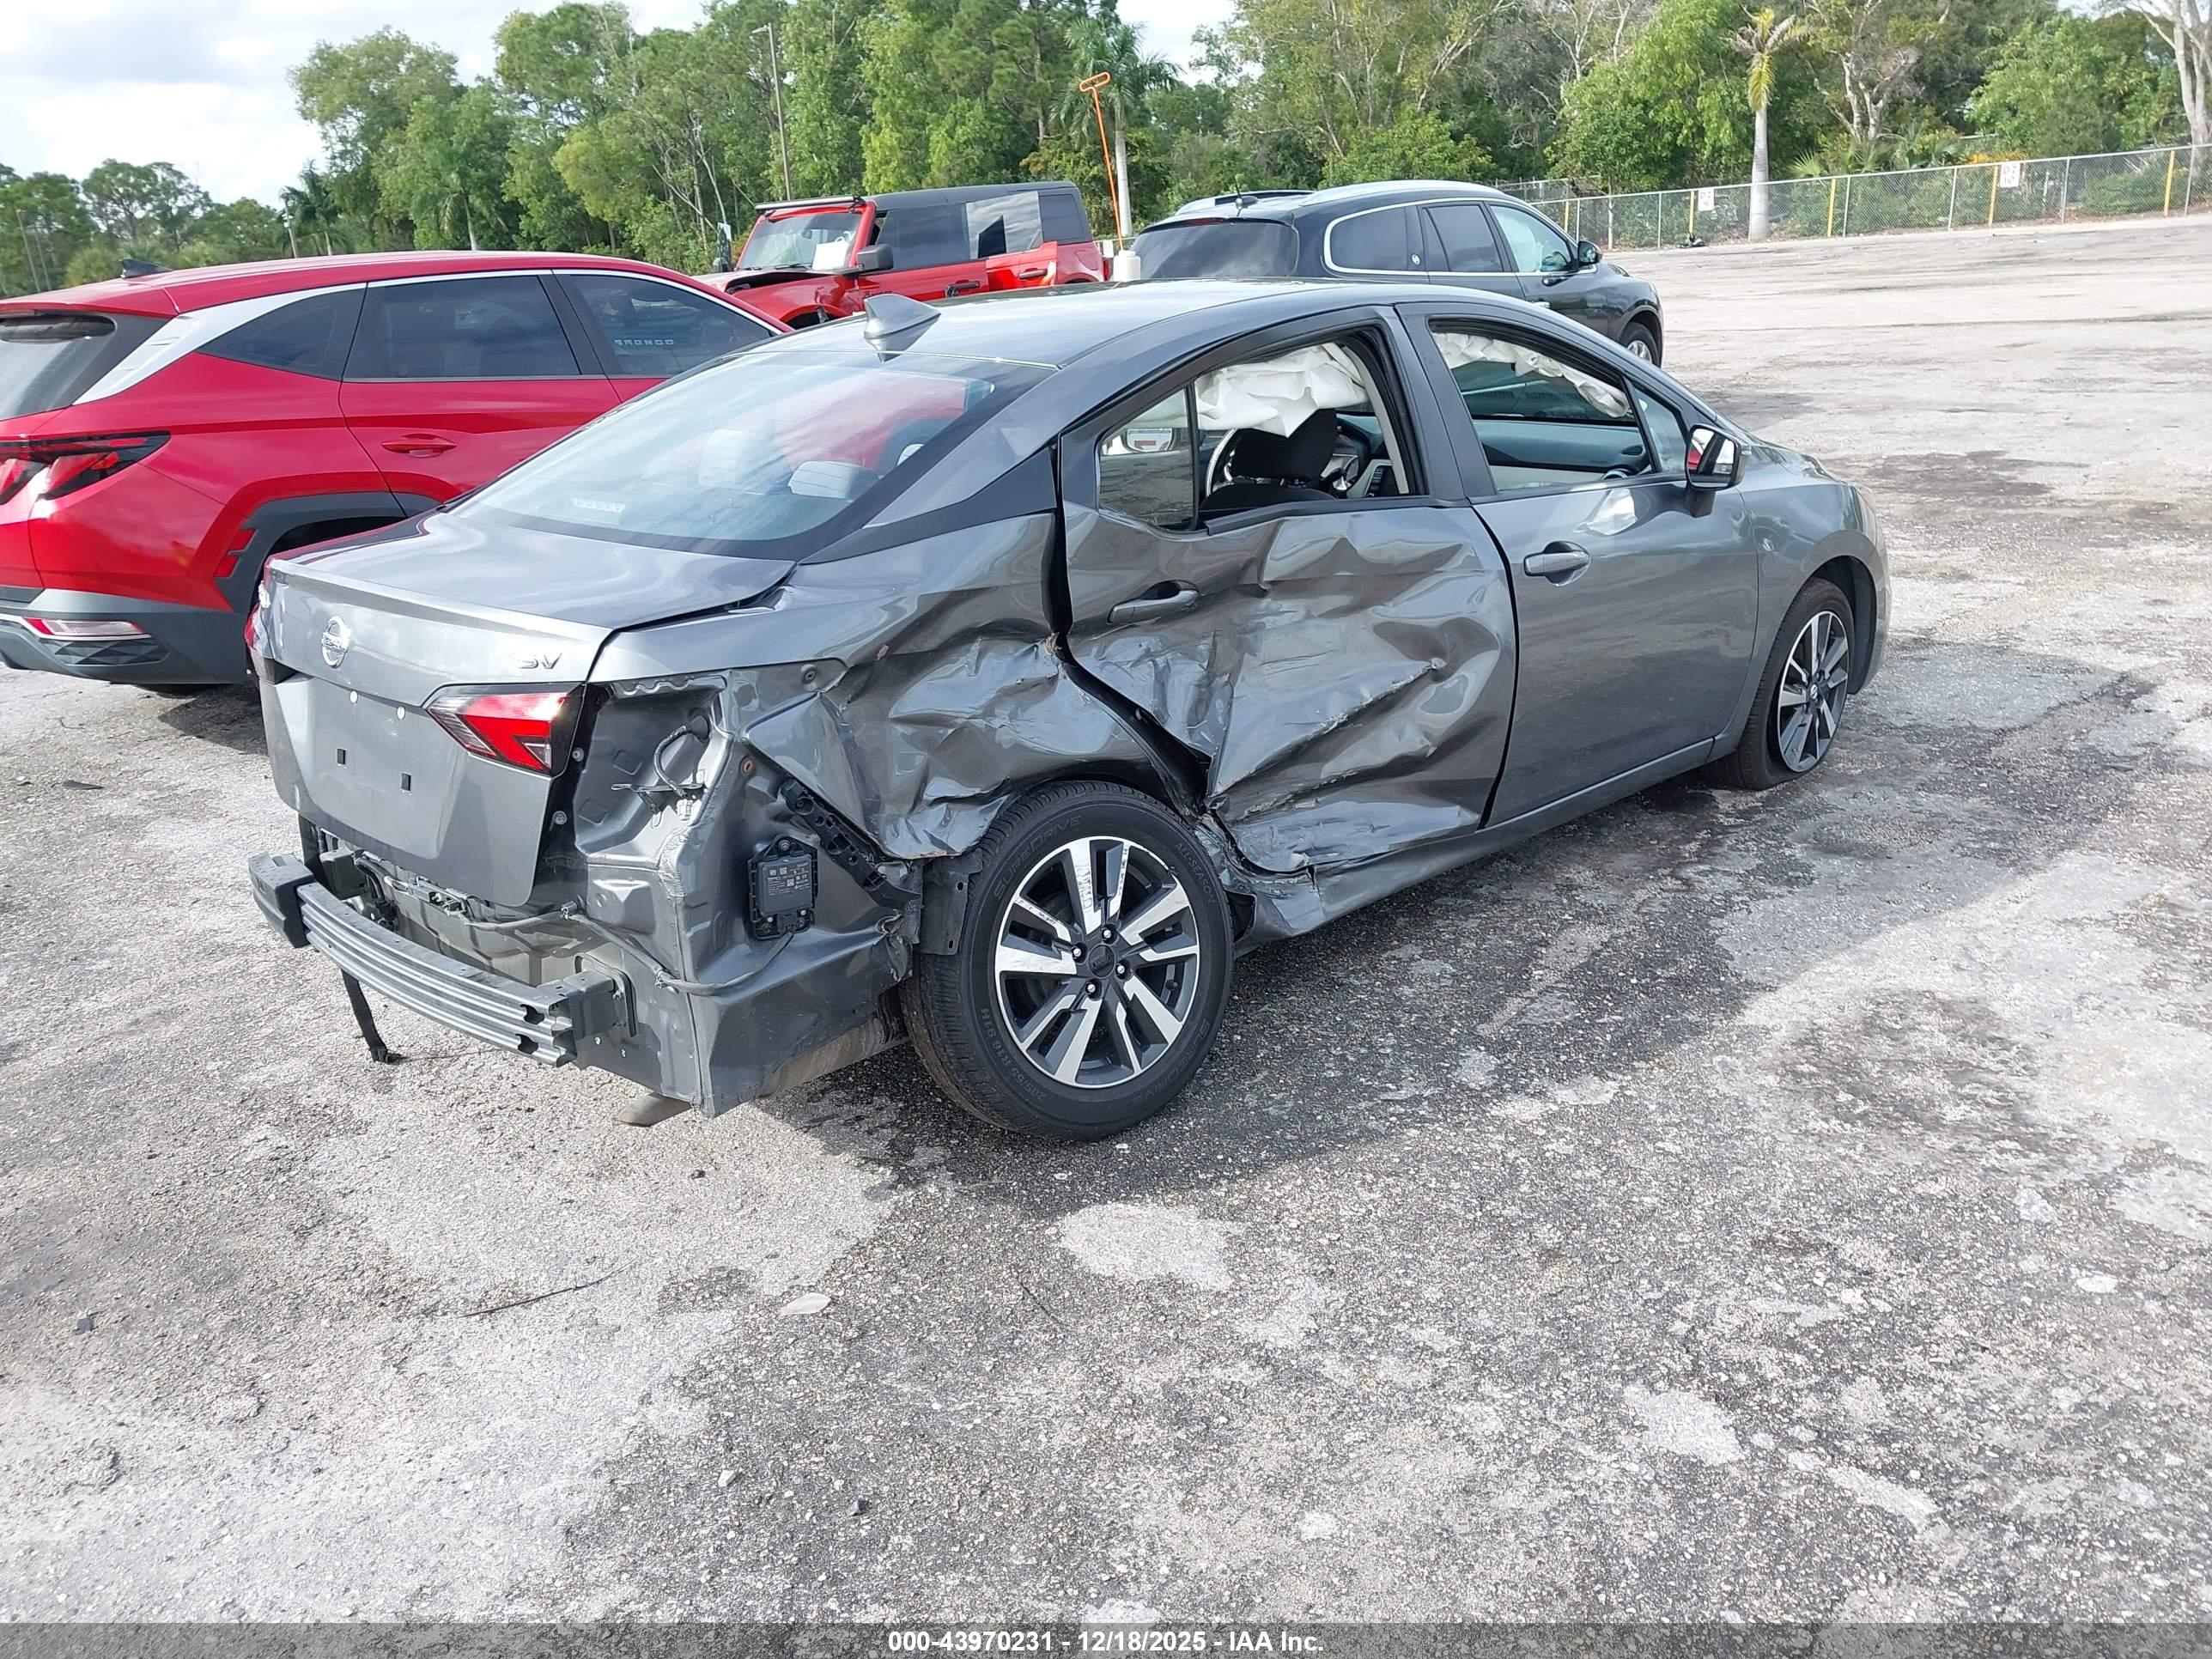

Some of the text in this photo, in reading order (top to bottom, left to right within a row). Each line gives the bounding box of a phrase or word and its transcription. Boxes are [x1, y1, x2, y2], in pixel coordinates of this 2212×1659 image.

[516, 652, 563, 670] SV
[1174, 843, 1216, 903] ALL-SEASON
[981, 1008, 1047, 1100] 205/55 R16 91H
